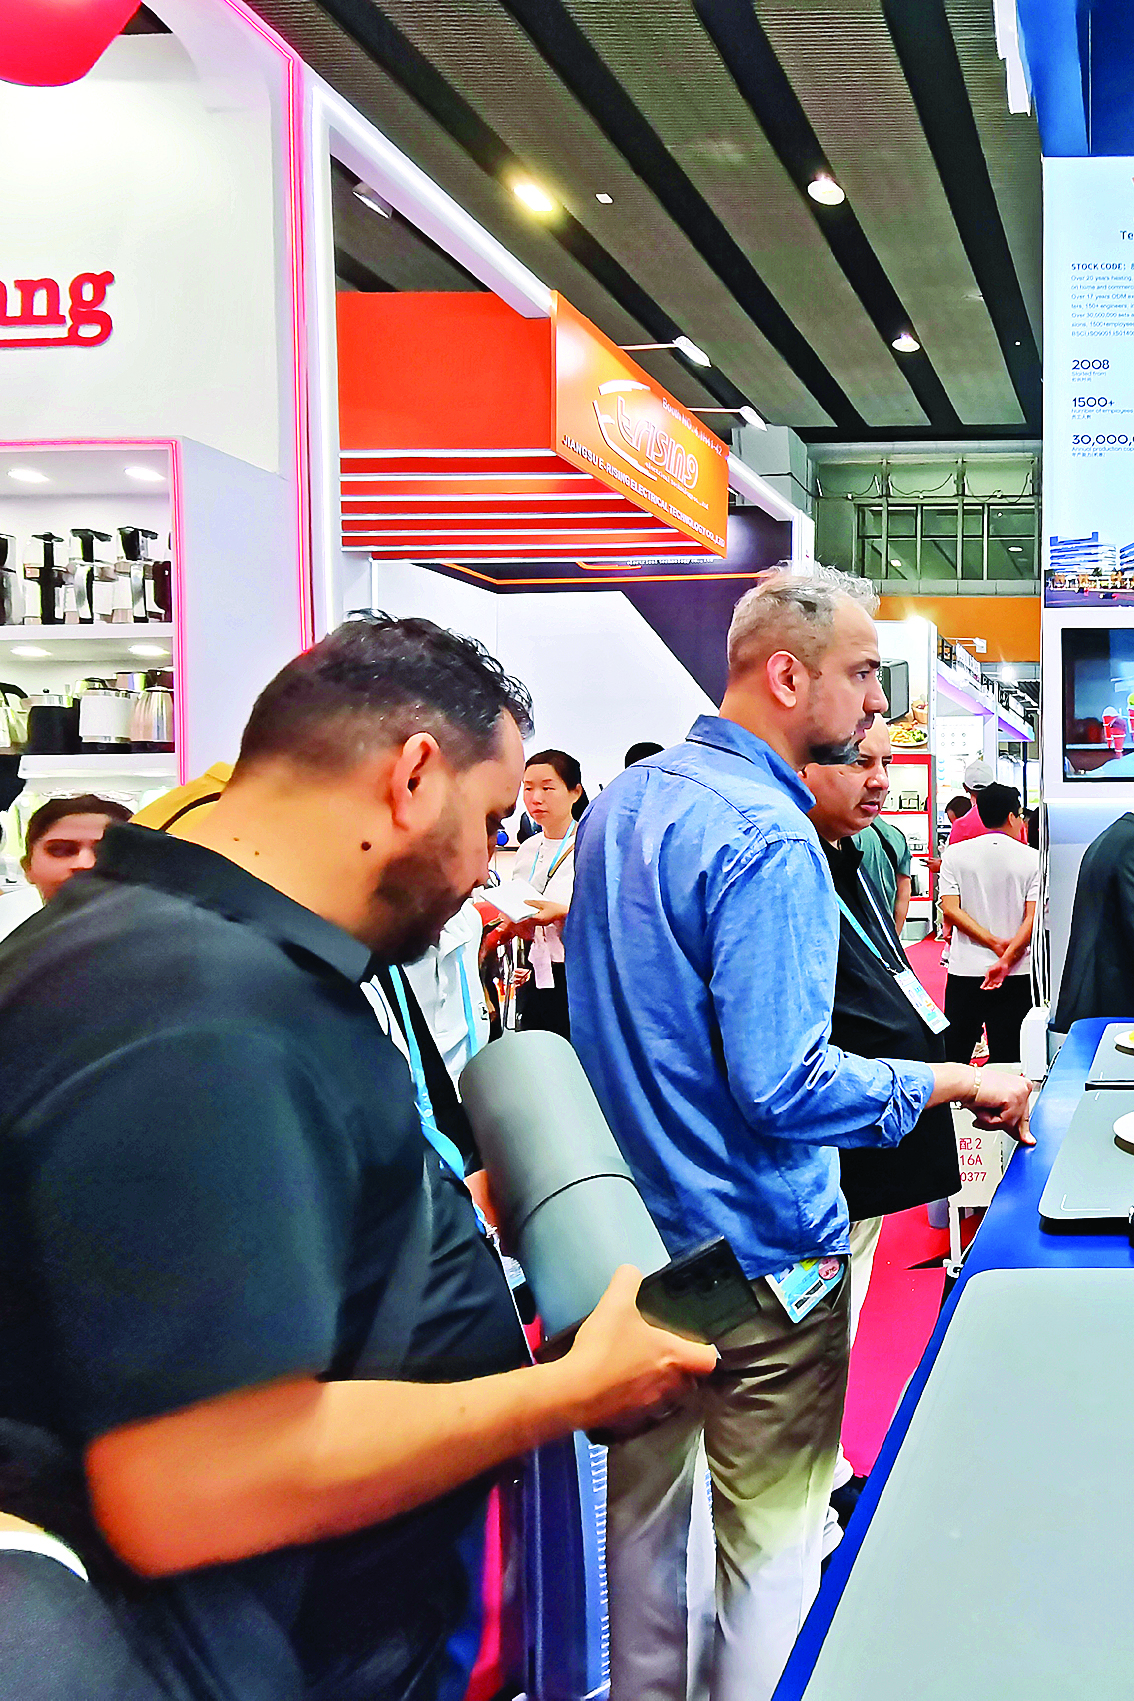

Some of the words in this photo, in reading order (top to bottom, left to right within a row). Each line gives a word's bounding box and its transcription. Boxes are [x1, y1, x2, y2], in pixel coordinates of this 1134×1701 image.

[0, 271, 115, 347] ng
[1072, 359, 1109, 370] 2008
[1072, 397, 1115, 408] 1500+
[562, 435, 598, 466] JIANGSU
[598, 457, 631, 486] E-RISING
[630, 479, 669, 512] ELECTRICAL
[668, 504, 706, 535] TECHNOLOGY
[975, 1138, 983, 1150] 2
[960, 1154, 983, 1166] 16A
[960, 1172, 987, 1182] 0377
